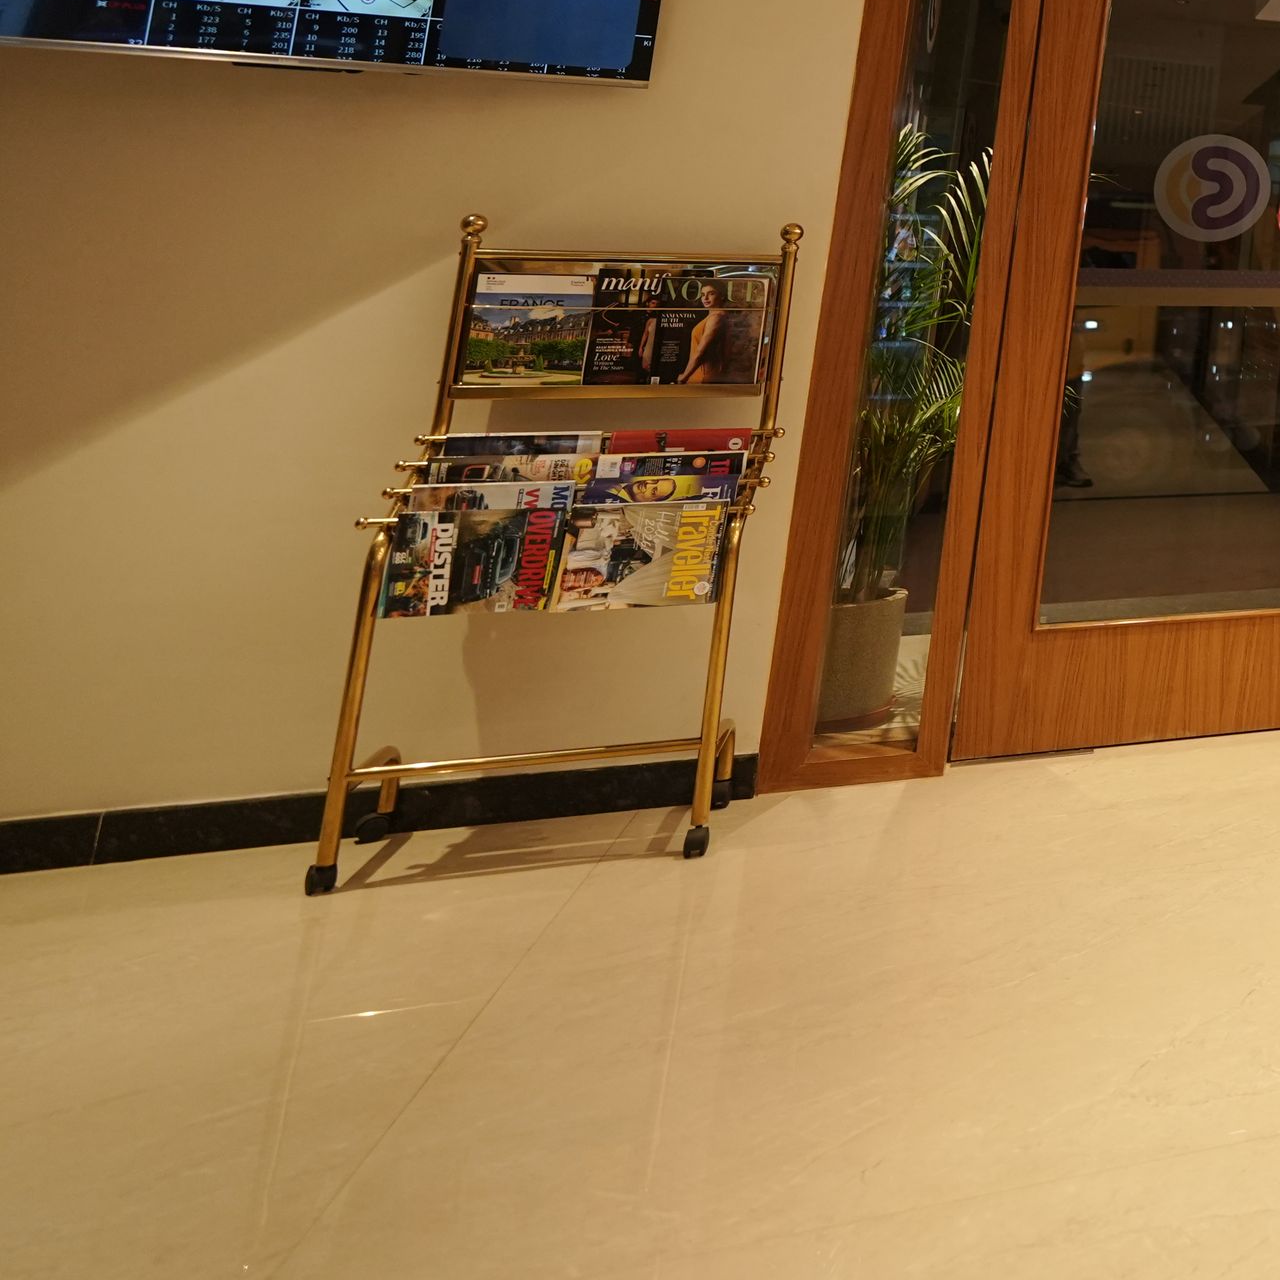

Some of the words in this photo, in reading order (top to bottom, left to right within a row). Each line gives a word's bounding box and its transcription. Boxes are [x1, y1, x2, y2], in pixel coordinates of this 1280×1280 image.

[162, 1, 177, 9] CH
[237, 7, 252, 15] CH
[305, 12, 319, 20] CH
[666, 279, 767, 302] VOUE
[500, 299, 566, 310] FRANCE
[512, 510, 557, 609] OVERDRIVE
[667, 505, 722, 600] Traveller
[428, 522, 455, 607] DUSTER
